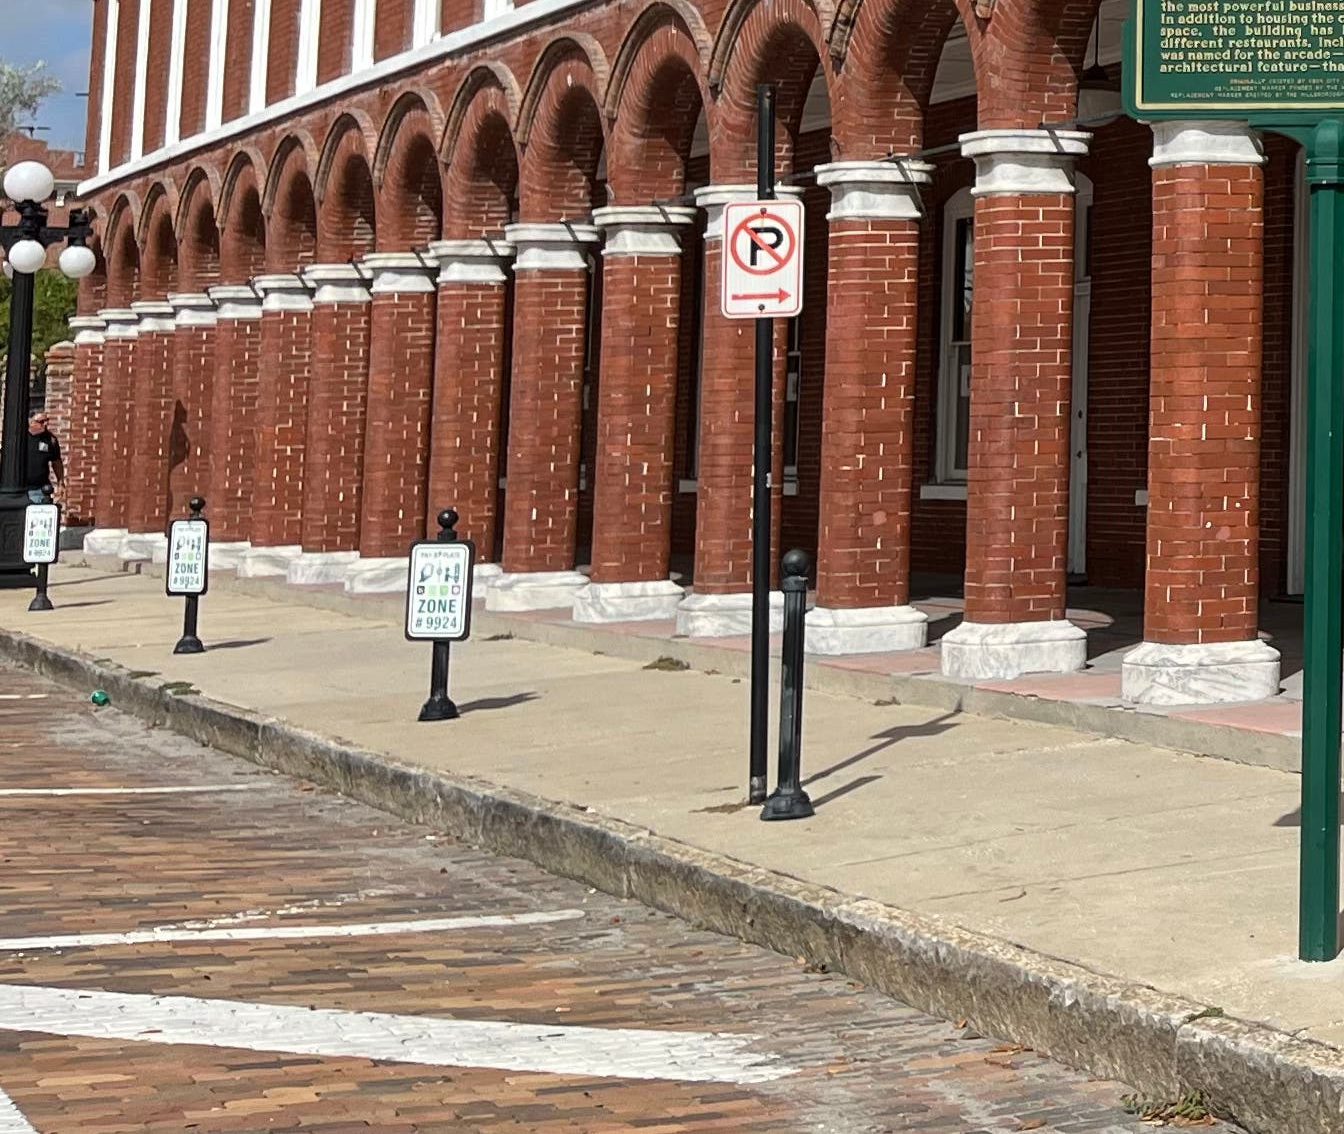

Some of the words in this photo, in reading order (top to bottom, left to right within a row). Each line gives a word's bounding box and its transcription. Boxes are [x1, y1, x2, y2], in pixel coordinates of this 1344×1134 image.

[1160, 2, 1184, 12] the
[1187, 1, 1220, 11] most
[1222, 1, 1285, 13] powerful
[1160, 15, 1175, 25] In
[1177, 14, 1236, 24] addition
[1239, 14, 1254, 24] to
[1256, 14, 1309, 26] housing
[1311, 14, 1335, 24] the
[1160, 29, 1203, 39] space,
[1212, 26, 1236, 36] the
[1244, 26, 1302, 38] building
[1310, 26, 1334, 36] has
[1160, 38, 1223, 48] different
[1228, 38, 1312, 49] restaurants,
[1160, 52, 1184, 60] was
[1187, 50, 1231, 60] named
[1234, 50, 1255, 60] for
[1257, 50, 1281, 60] the
[1159, 62, 1253, 72] architectural
[175, 562, 199, 574] ZONE
[417, 598, 457, 614] ZONE
